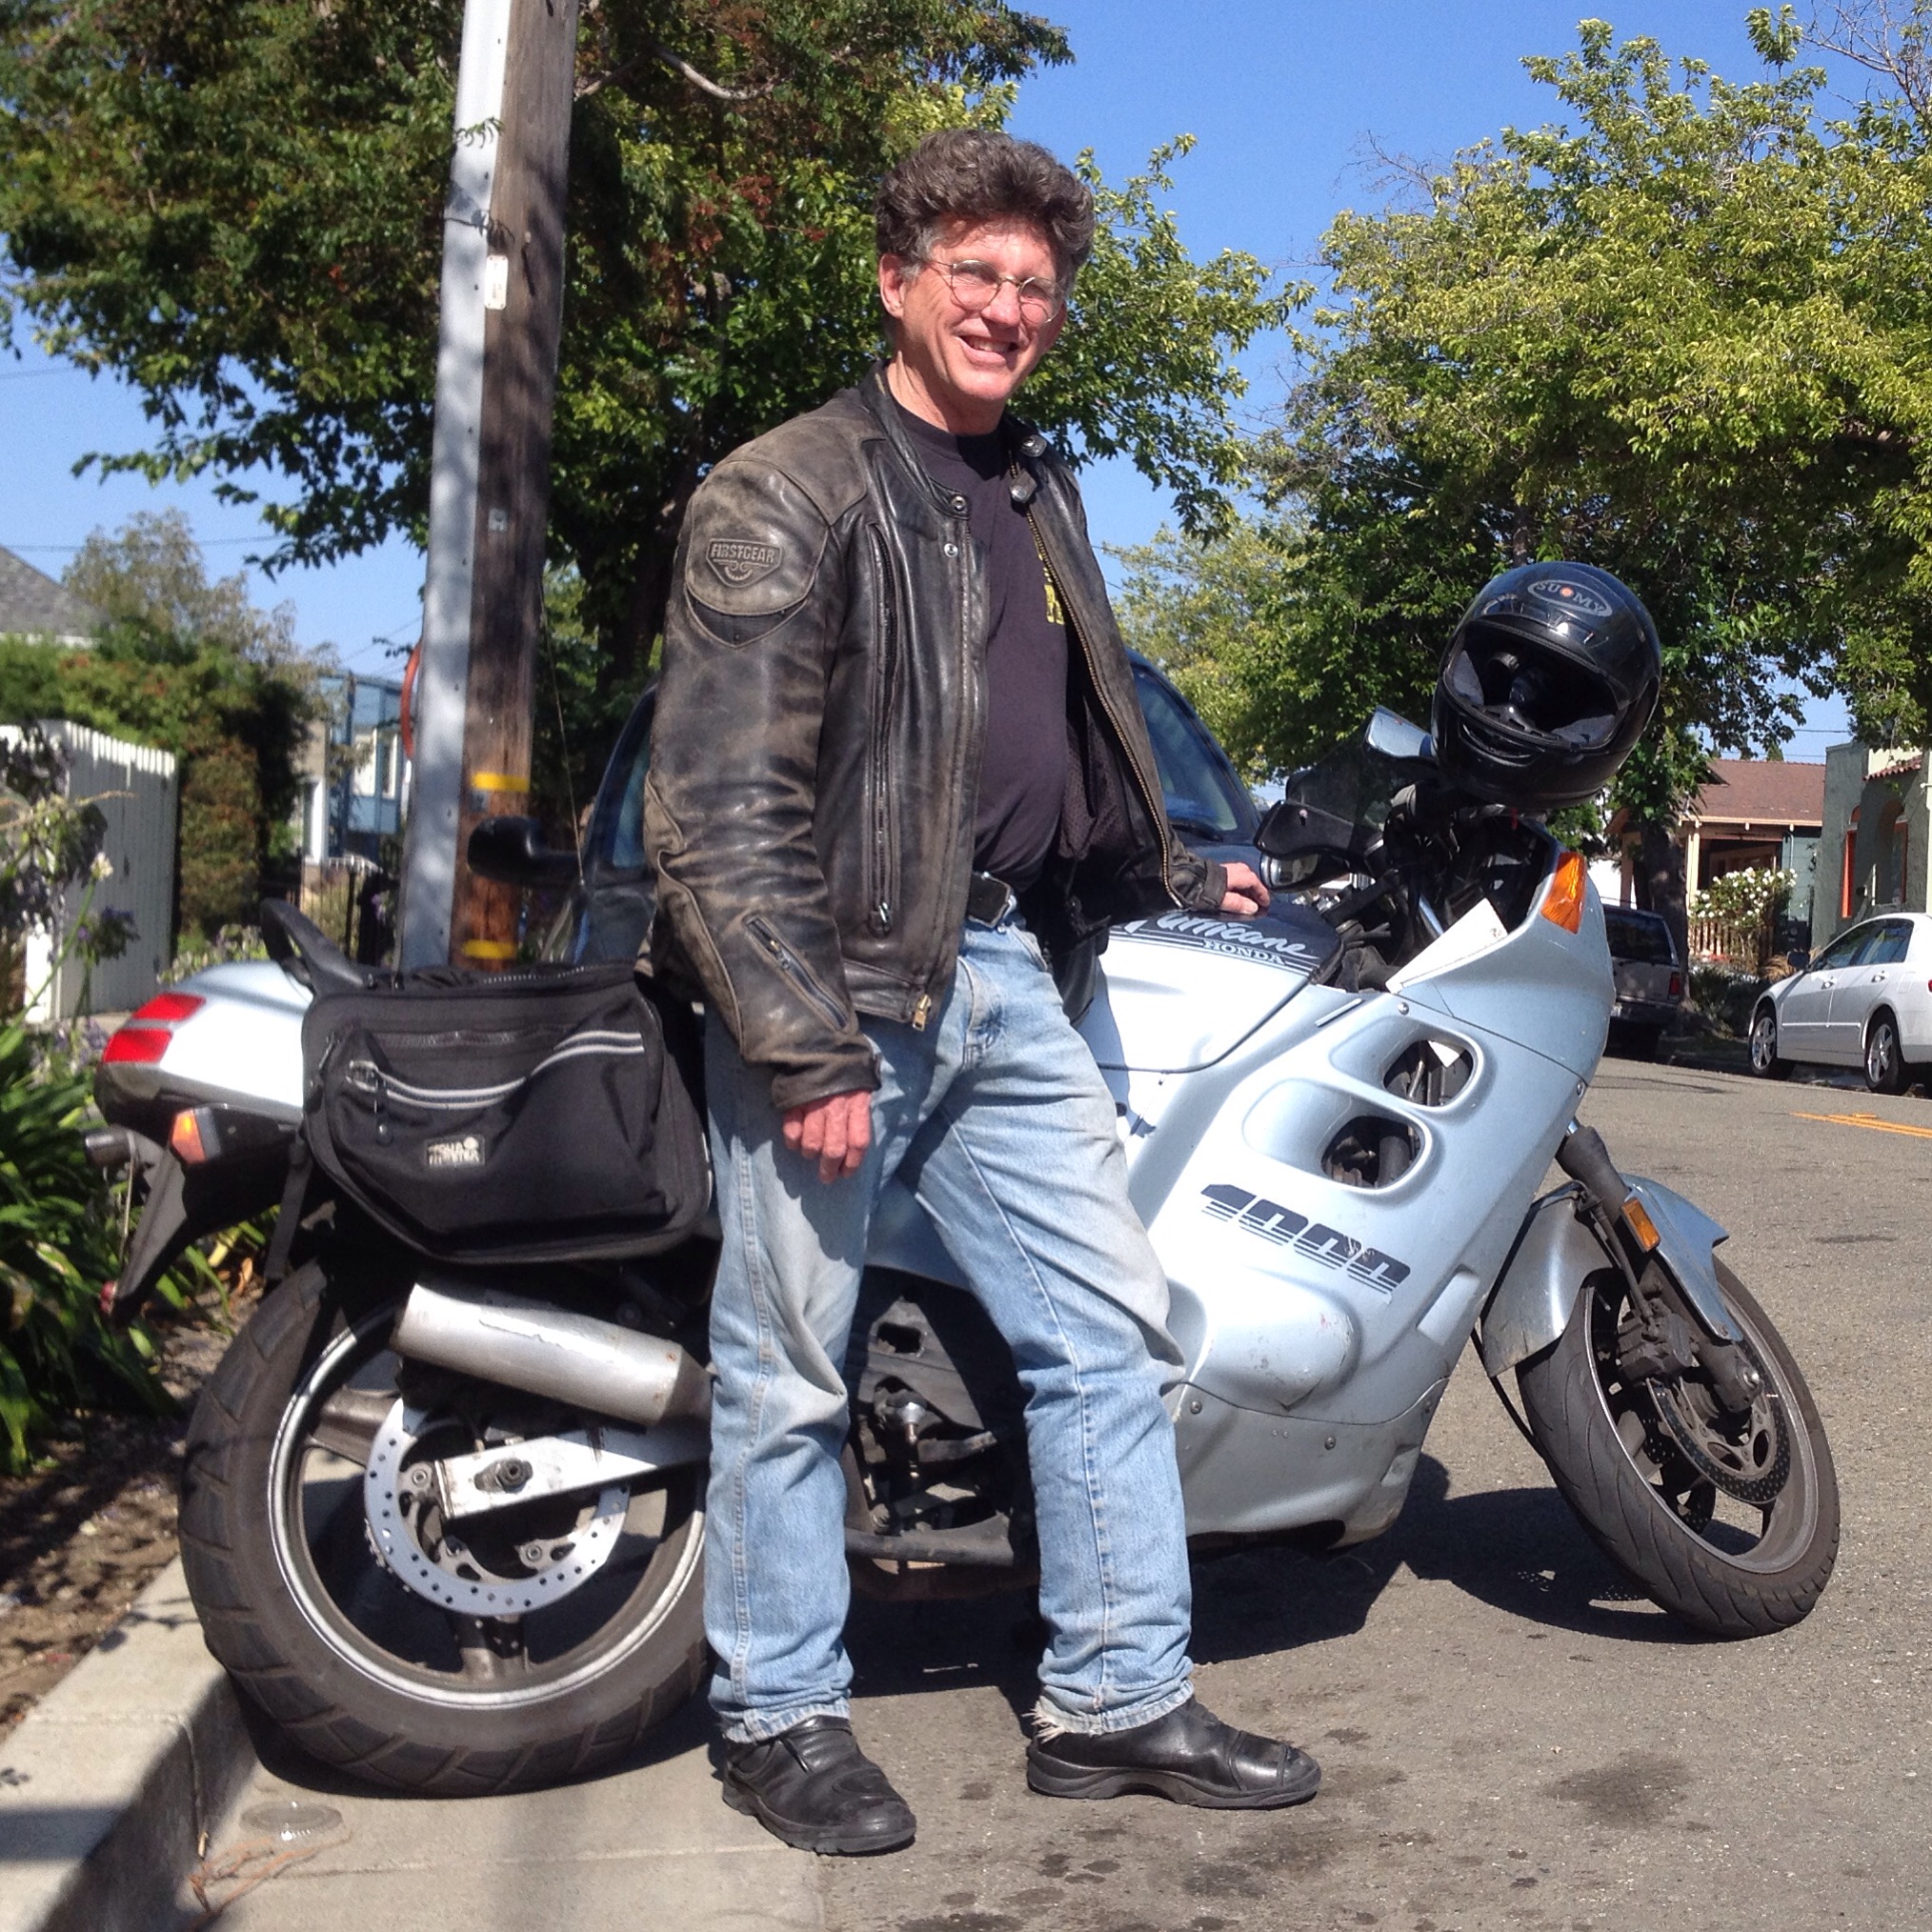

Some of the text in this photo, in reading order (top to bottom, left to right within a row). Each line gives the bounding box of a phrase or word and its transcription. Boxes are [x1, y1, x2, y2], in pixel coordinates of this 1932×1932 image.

[711, 543, 776, 564] FIRSTGEAR
[1202, 939, 1287, 966] HONDA
[1200, 1184, 1411, 1295] 1000
